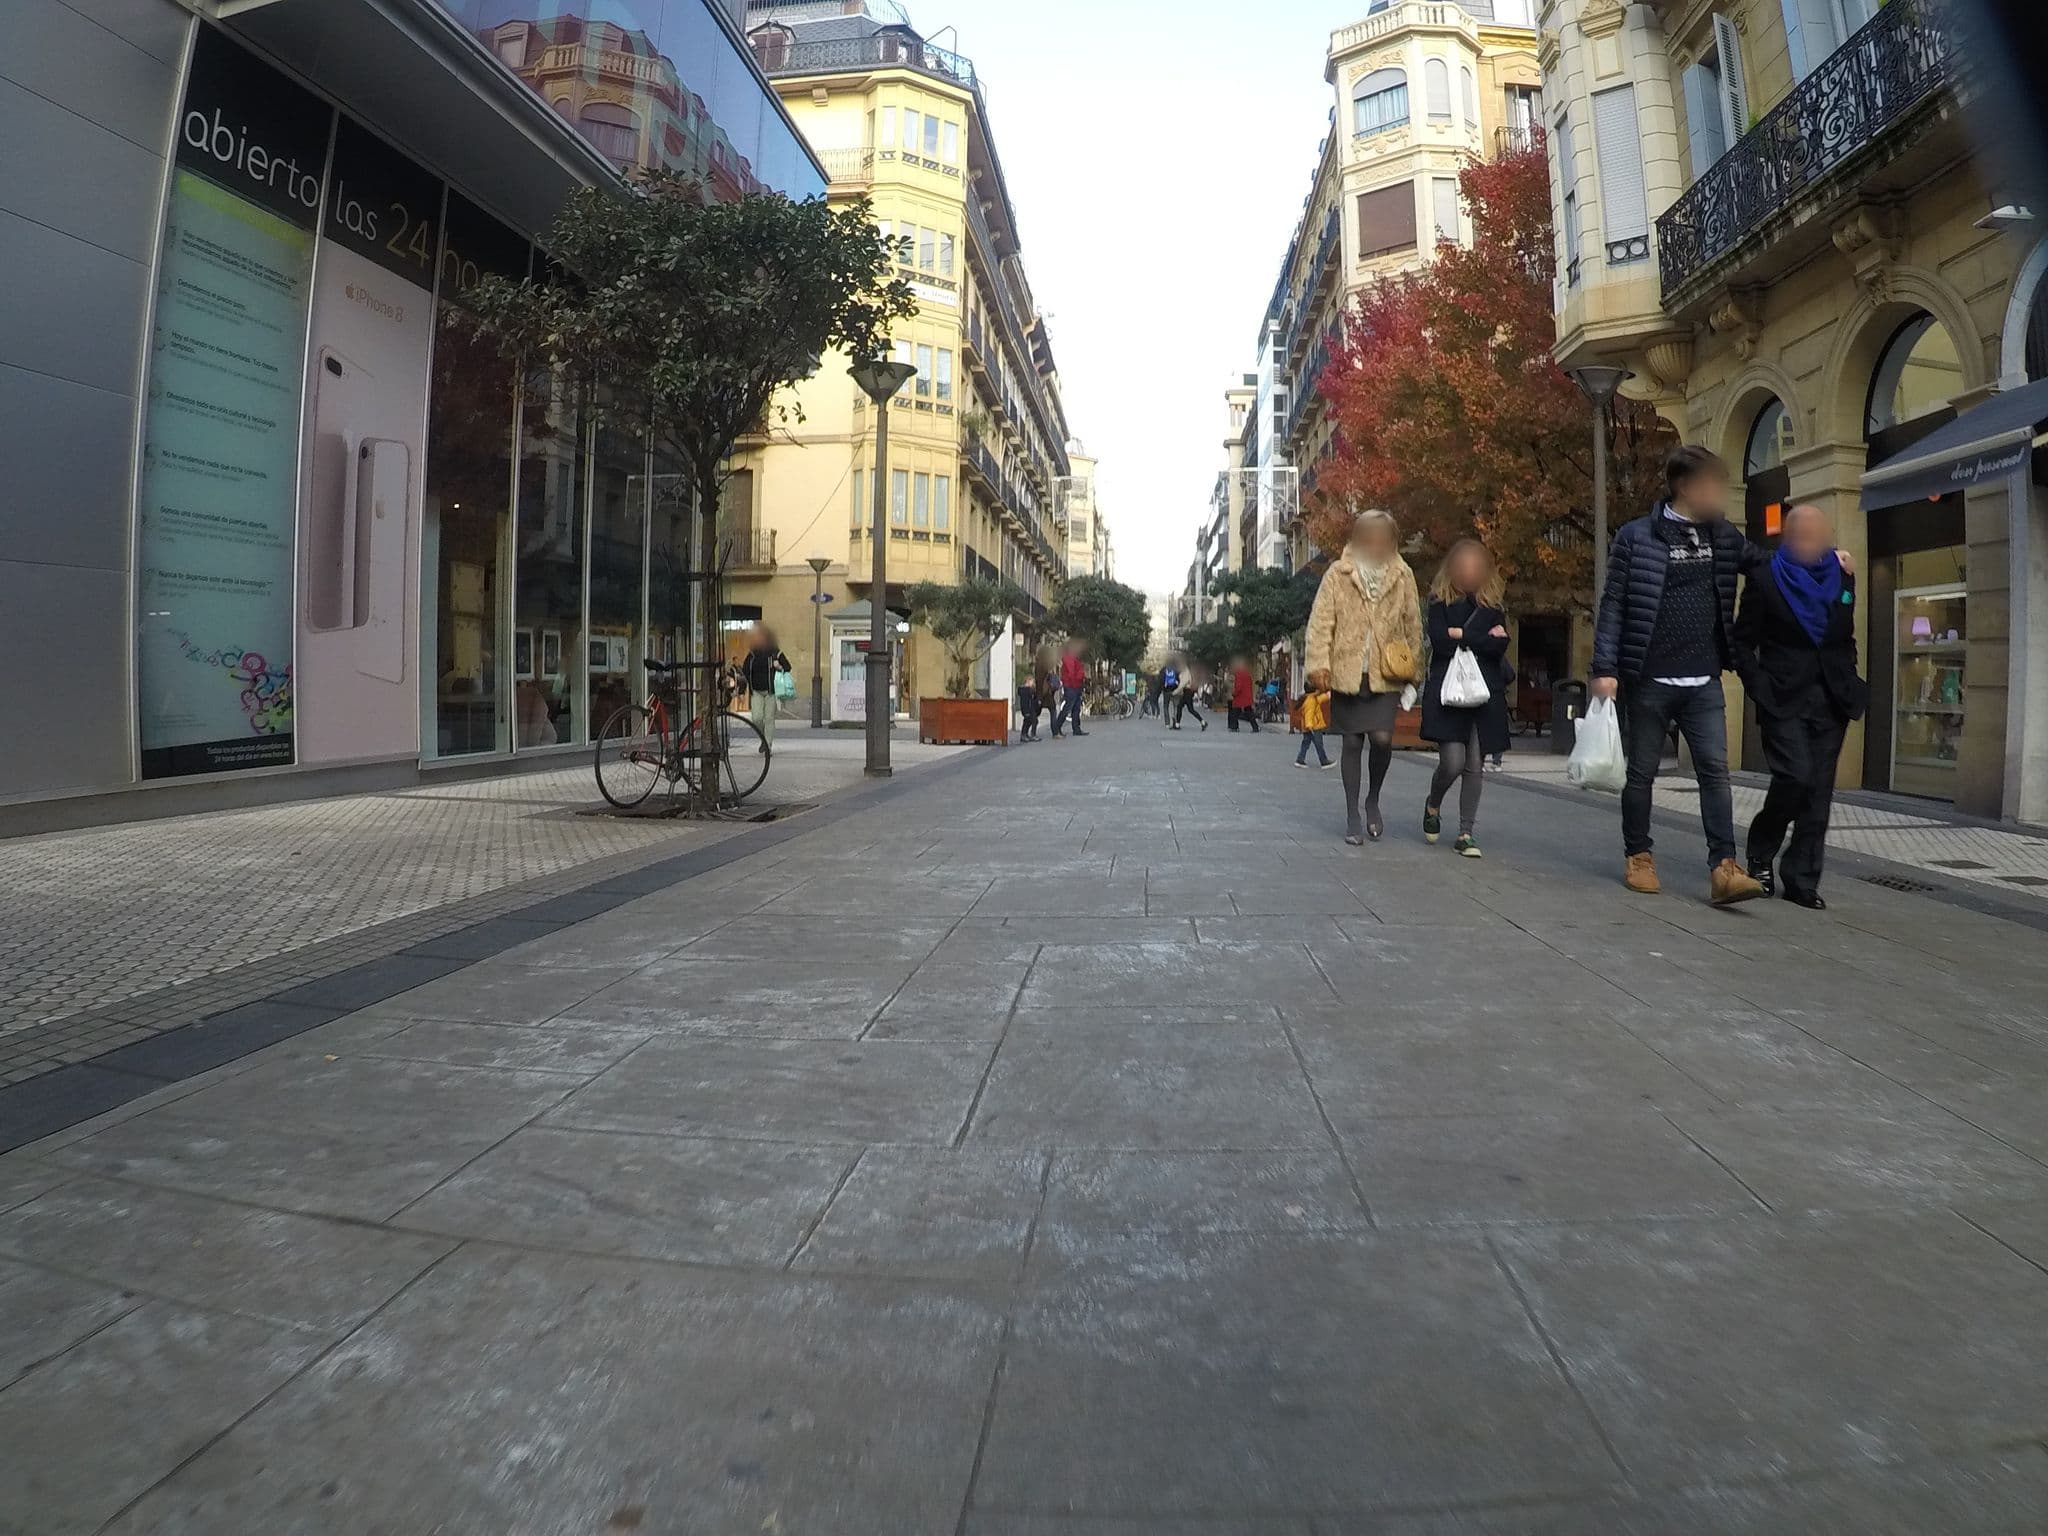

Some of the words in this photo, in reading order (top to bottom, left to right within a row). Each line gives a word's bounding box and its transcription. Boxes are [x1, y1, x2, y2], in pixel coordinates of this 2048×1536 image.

[184, 108, 319, 208] abierto
[336, 180, 378, 241] las
[386, 202, 430, 269] 24
[354, 284, 393, 319] iPhone
[394, 307, 404, 323] 8
